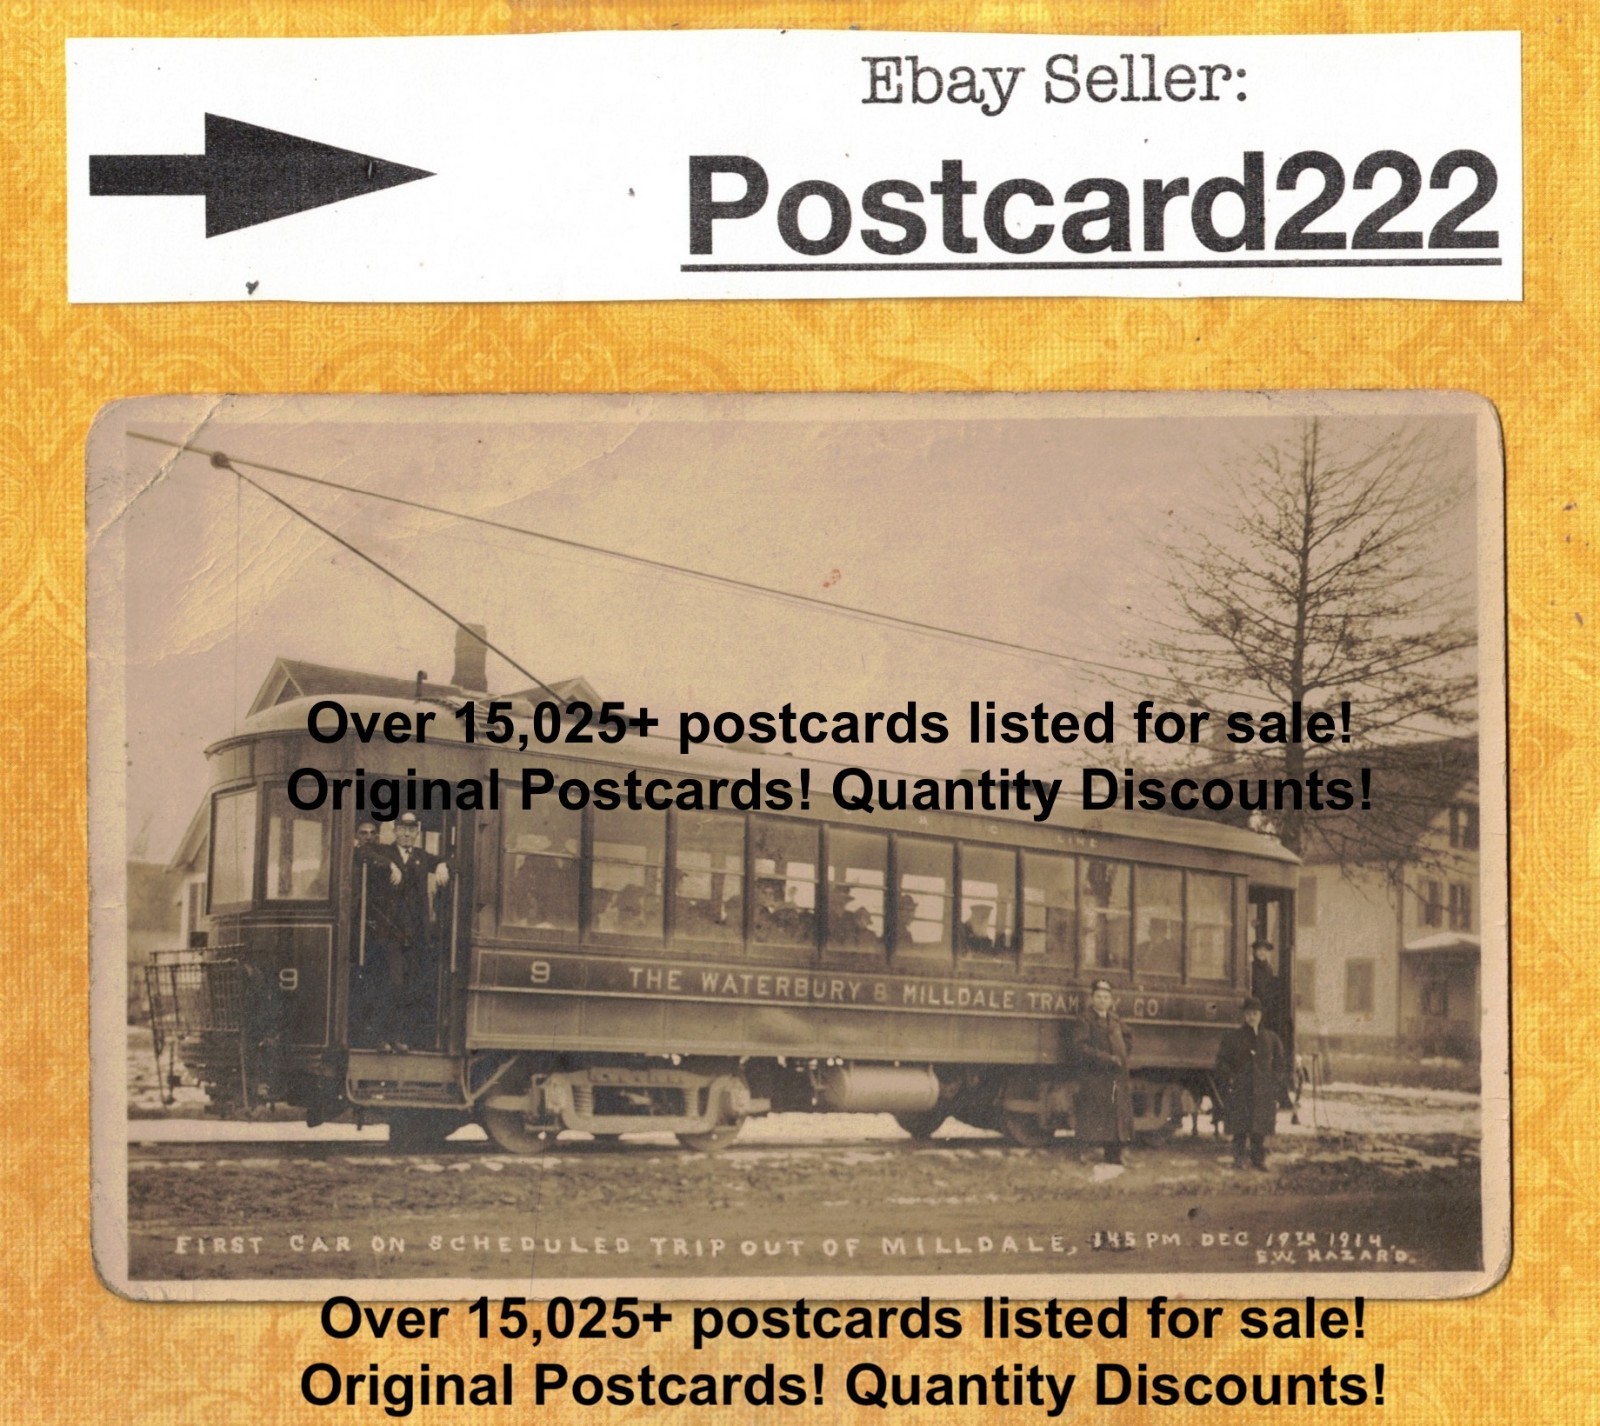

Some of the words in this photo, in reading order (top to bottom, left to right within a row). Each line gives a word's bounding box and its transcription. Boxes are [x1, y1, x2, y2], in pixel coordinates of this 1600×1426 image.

[862, 56, 1026, 115] Ebay
[1045, 53, 1248, 104] Seller:
[687, 149, 1500, 256] Postcard222
[279, 967, 298, 991] 9
[530, 961, 551, 984] 9
[628, 967, 684, 992] THE
[701, 972, 862, 1001] WATERBURY
[902, 984, 1016, 1010] MILLDALE
[174, 1235, 263, 1255] FIRST
[289, 1234, 351, 1253] CAR
[371, 1234, 405, 1253] ON
[428, 1234, 630, 1255] SCHEDULED
[649, 1237, 725, 1257] TRIP
[740, 1239, 804, 1257] OUT
[822, 1239, 860, 1256] OF
[881, 1235, 1078, 1256] MILLDALE,
[1146, 1232, 1182, 1248] PM
[1201, 1231, 1250, 1247] DEC
